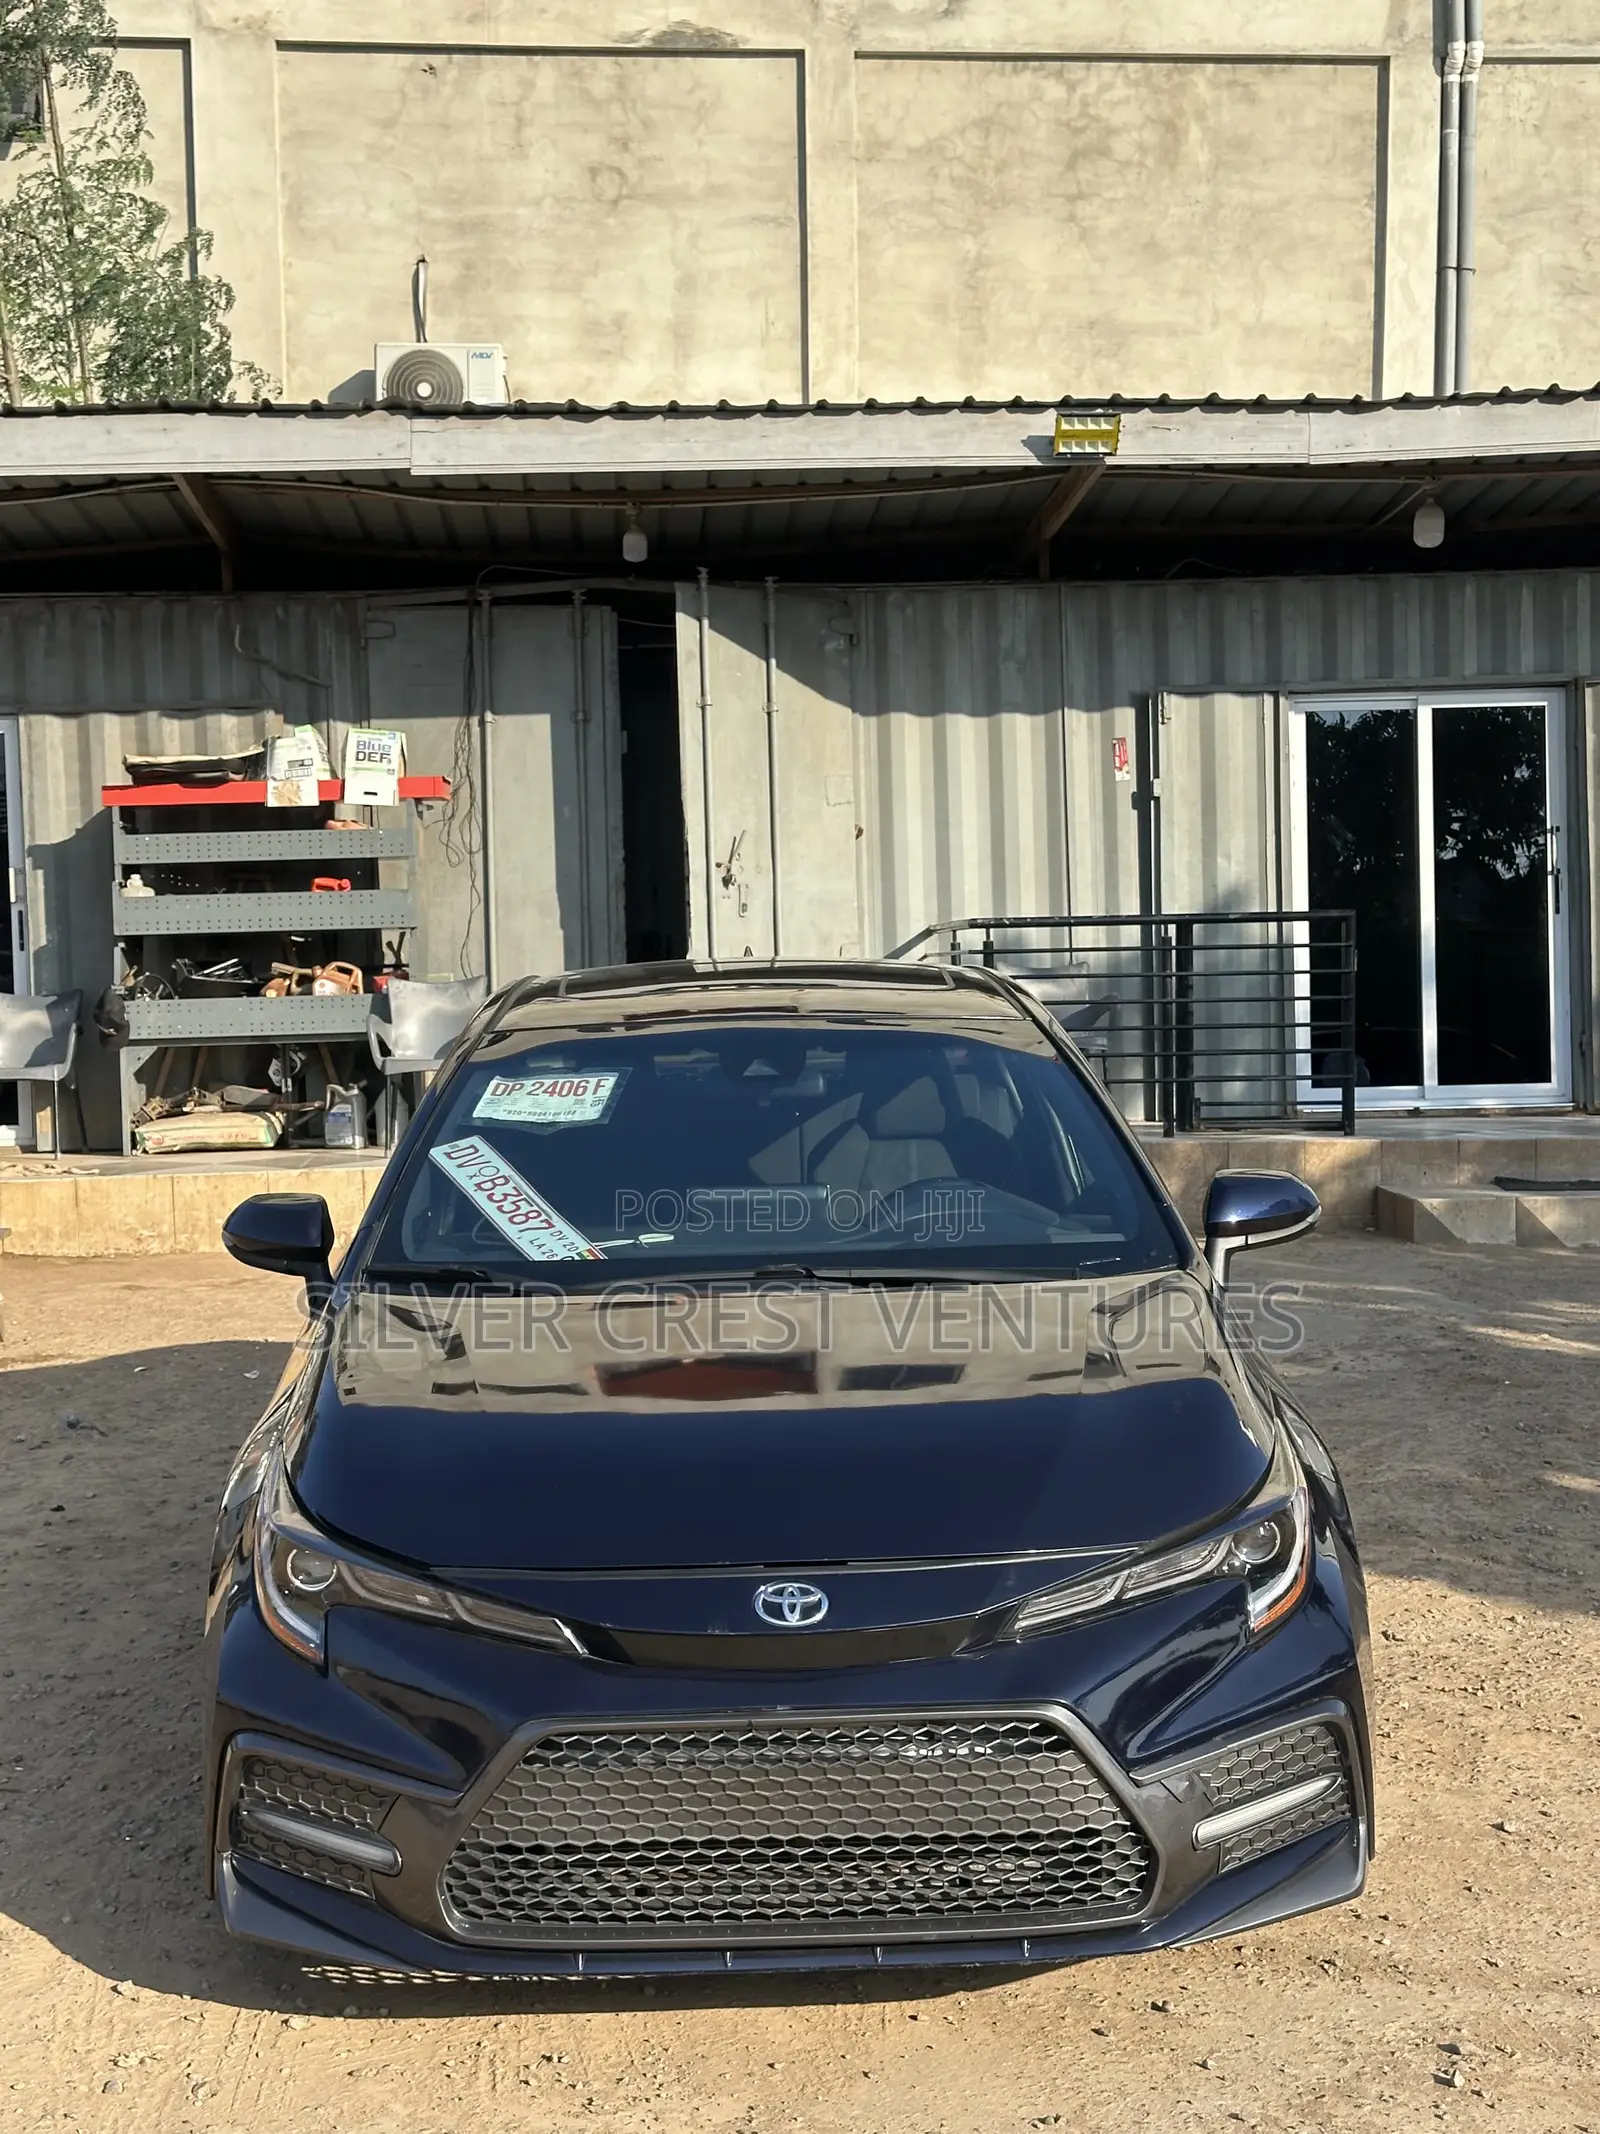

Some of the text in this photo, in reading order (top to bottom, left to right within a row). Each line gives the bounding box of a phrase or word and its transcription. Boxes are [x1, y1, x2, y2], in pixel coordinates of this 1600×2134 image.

[356, 739, 392, 753] Blue
[355, 750, 391, 764] DEF
[490, 1078, 610, 1098] DP 2406 F
[443, 1144, 492, 1168] DV
[473, 1175, 556, 1233] B3587
[529, 1237, 547, 1250] LA
[549, 1230, 579, 1252] DV 20
